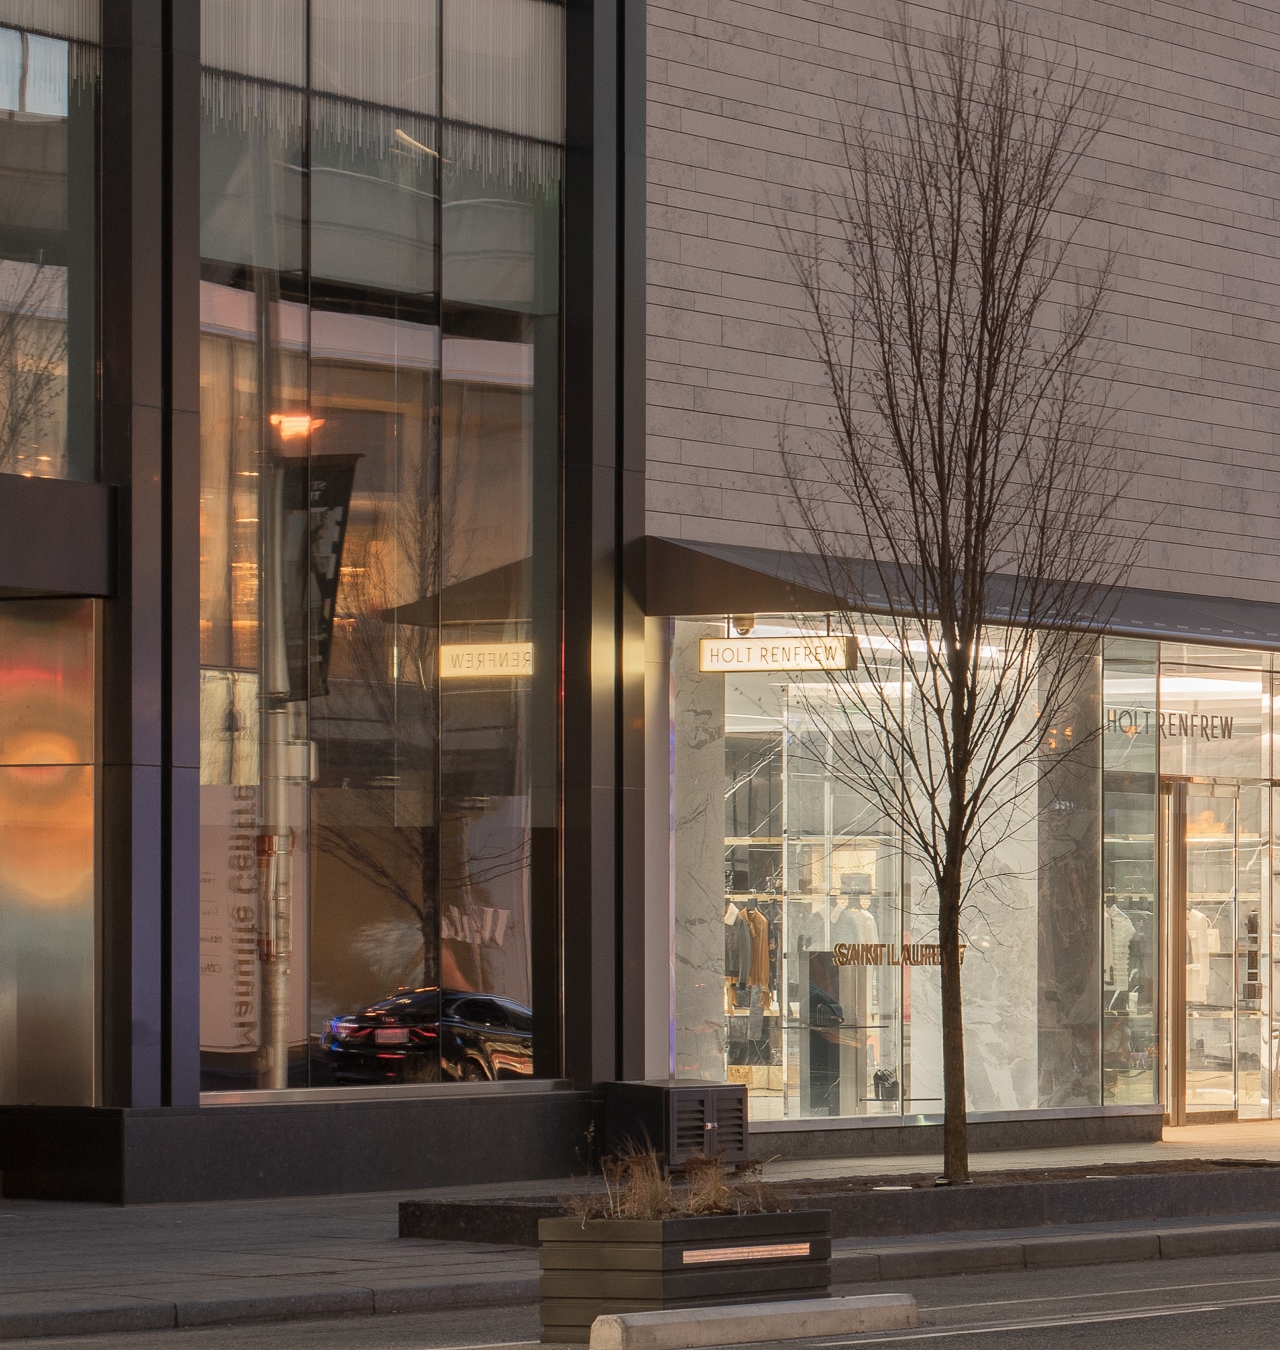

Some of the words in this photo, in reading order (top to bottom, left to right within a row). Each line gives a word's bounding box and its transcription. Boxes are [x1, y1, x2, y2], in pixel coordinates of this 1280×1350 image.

[711, 647, 751, 663] HOLT
[760, 646, 838, 664] RENFREW
[1107, 709, 1151, 735] HOLT
[1159, 712, 1234, 742] RENFREW
[832, 942, 886, 966] SAINT
